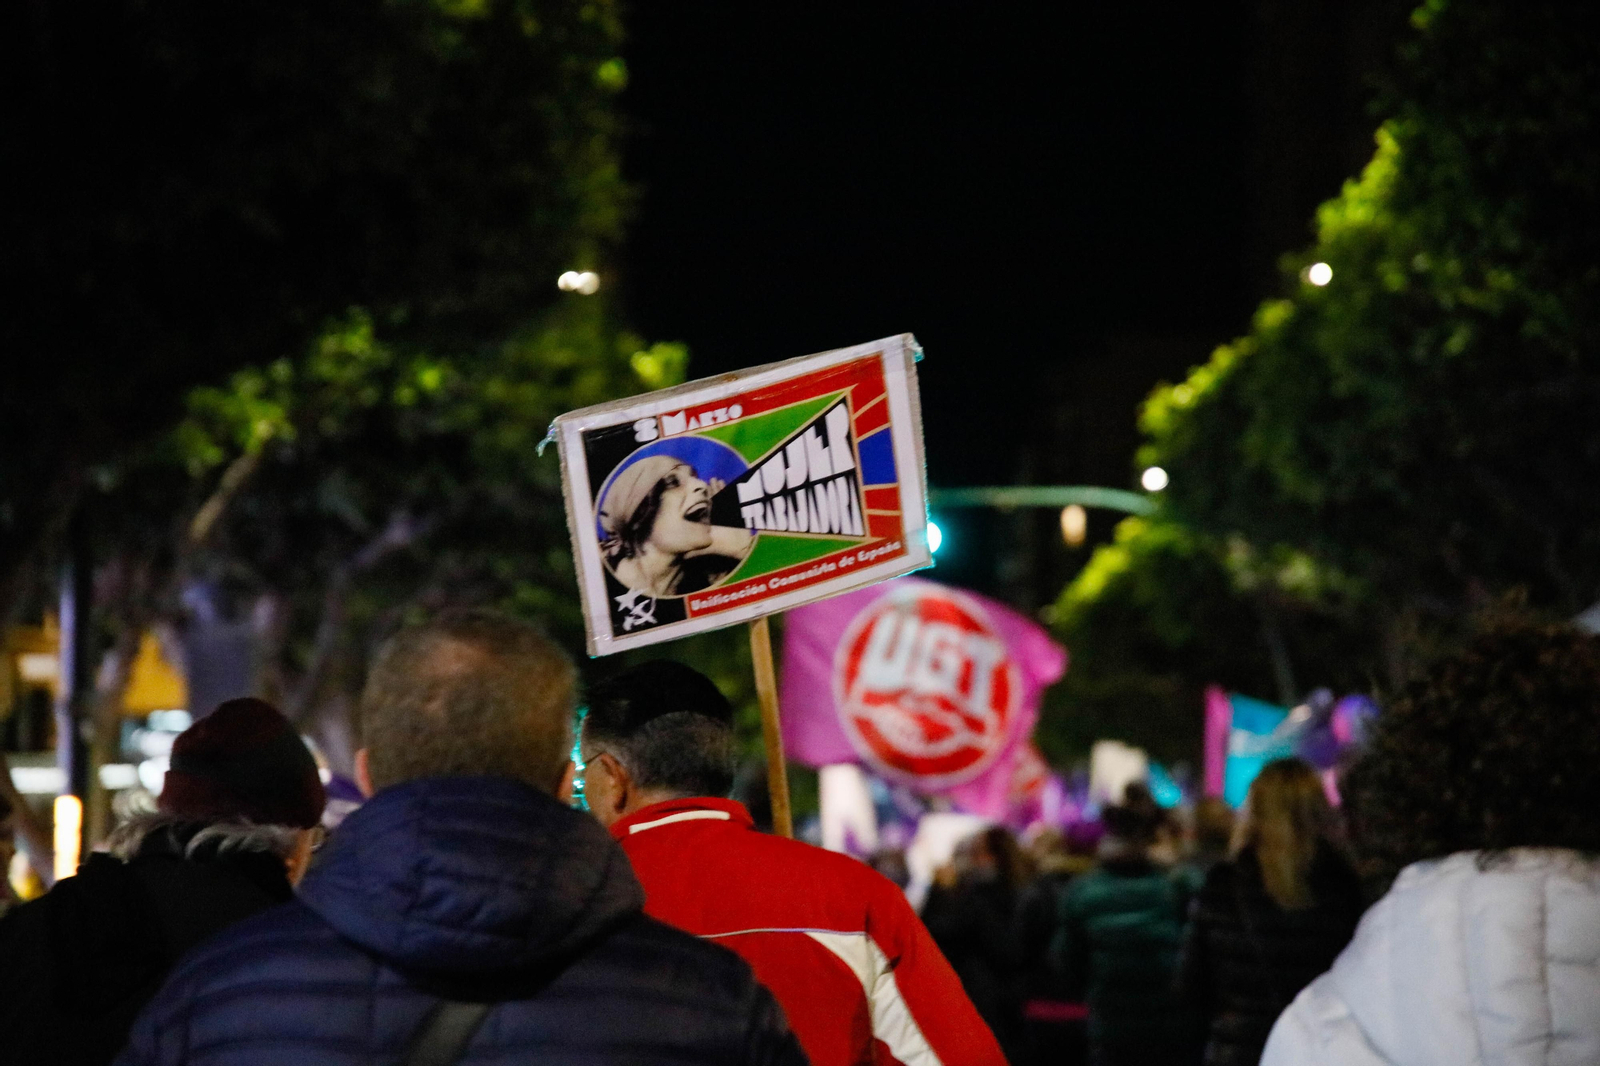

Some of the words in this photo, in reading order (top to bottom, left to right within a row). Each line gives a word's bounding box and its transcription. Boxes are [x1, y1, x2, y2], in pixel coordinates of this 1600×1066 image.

[633, 418, 658, 442] 8
[736, 402, 855, 504] MUJER
[740, 475, 865, 536] TRABAJADORA
[691, 583, 767, 611] Unificación
[768, 562, 837, 589] Comunista
[838, 555, 855, 568] de
[857, 541, 901, 562] España
[861, 611, 1006, 715] UGT
